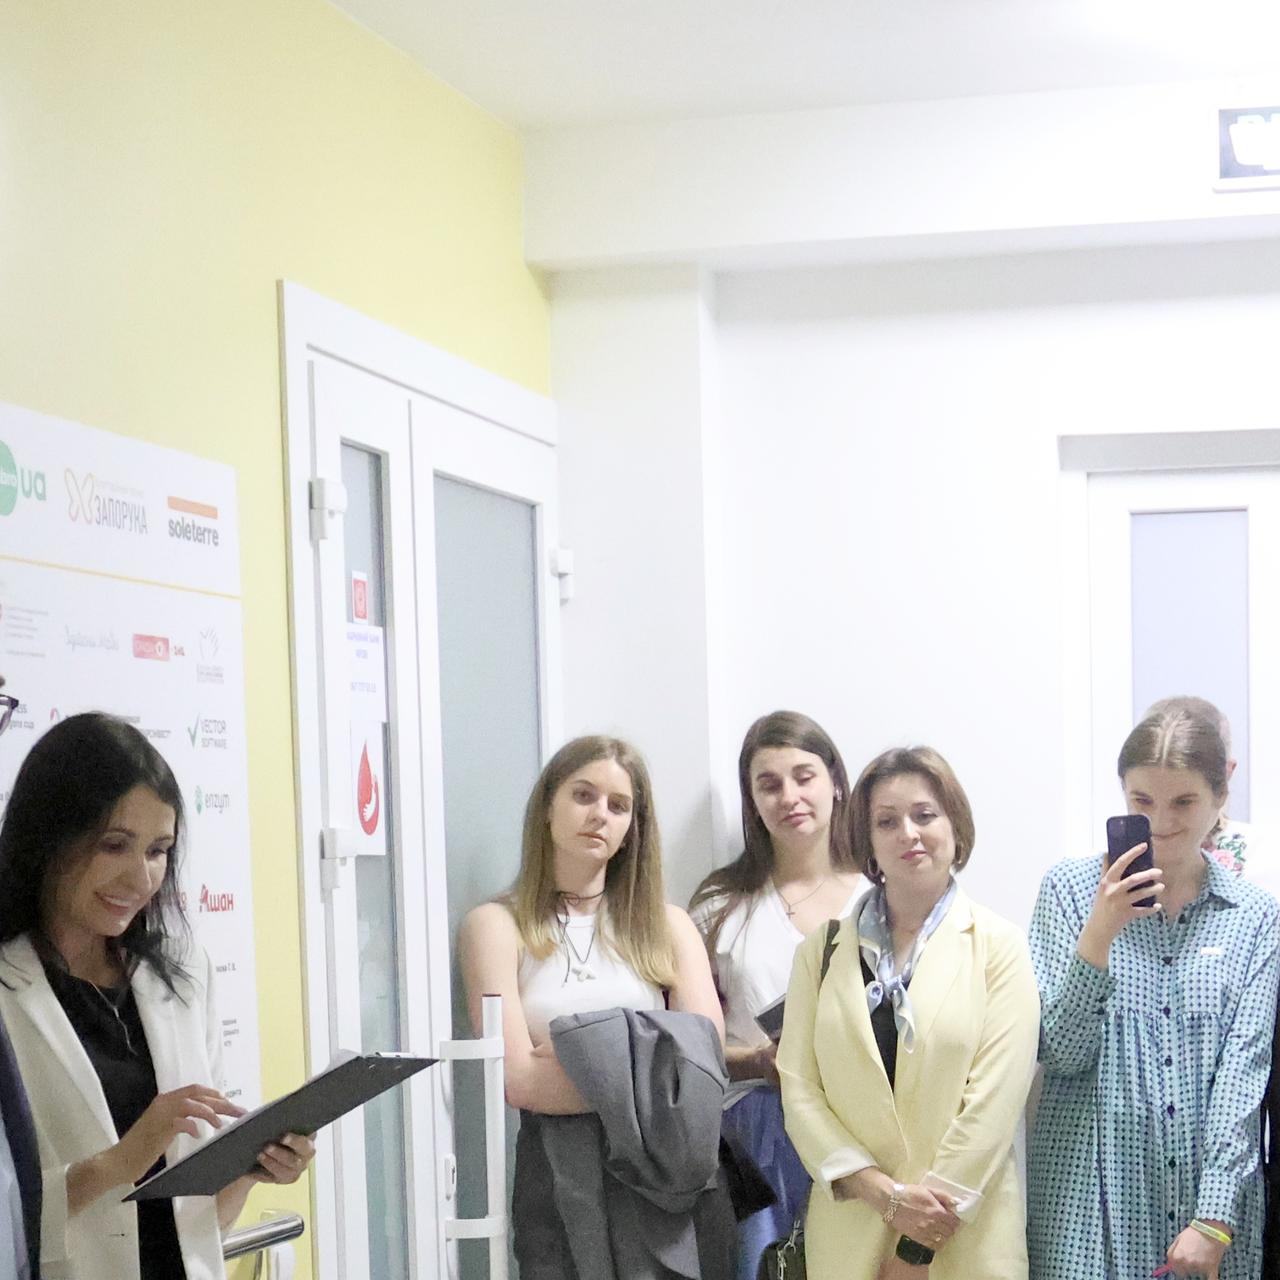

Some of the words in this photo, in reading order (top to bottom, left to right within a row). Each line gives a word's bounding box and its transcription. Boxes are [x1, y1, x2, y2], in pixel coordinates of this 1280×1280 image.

[94, 495, 148, 535] ЗАПОРУКА
[168, 516, 219, 547] soleterre
[200, 719, 227, 734] VECTOR
[199, 884, 234, 912] Ашан
